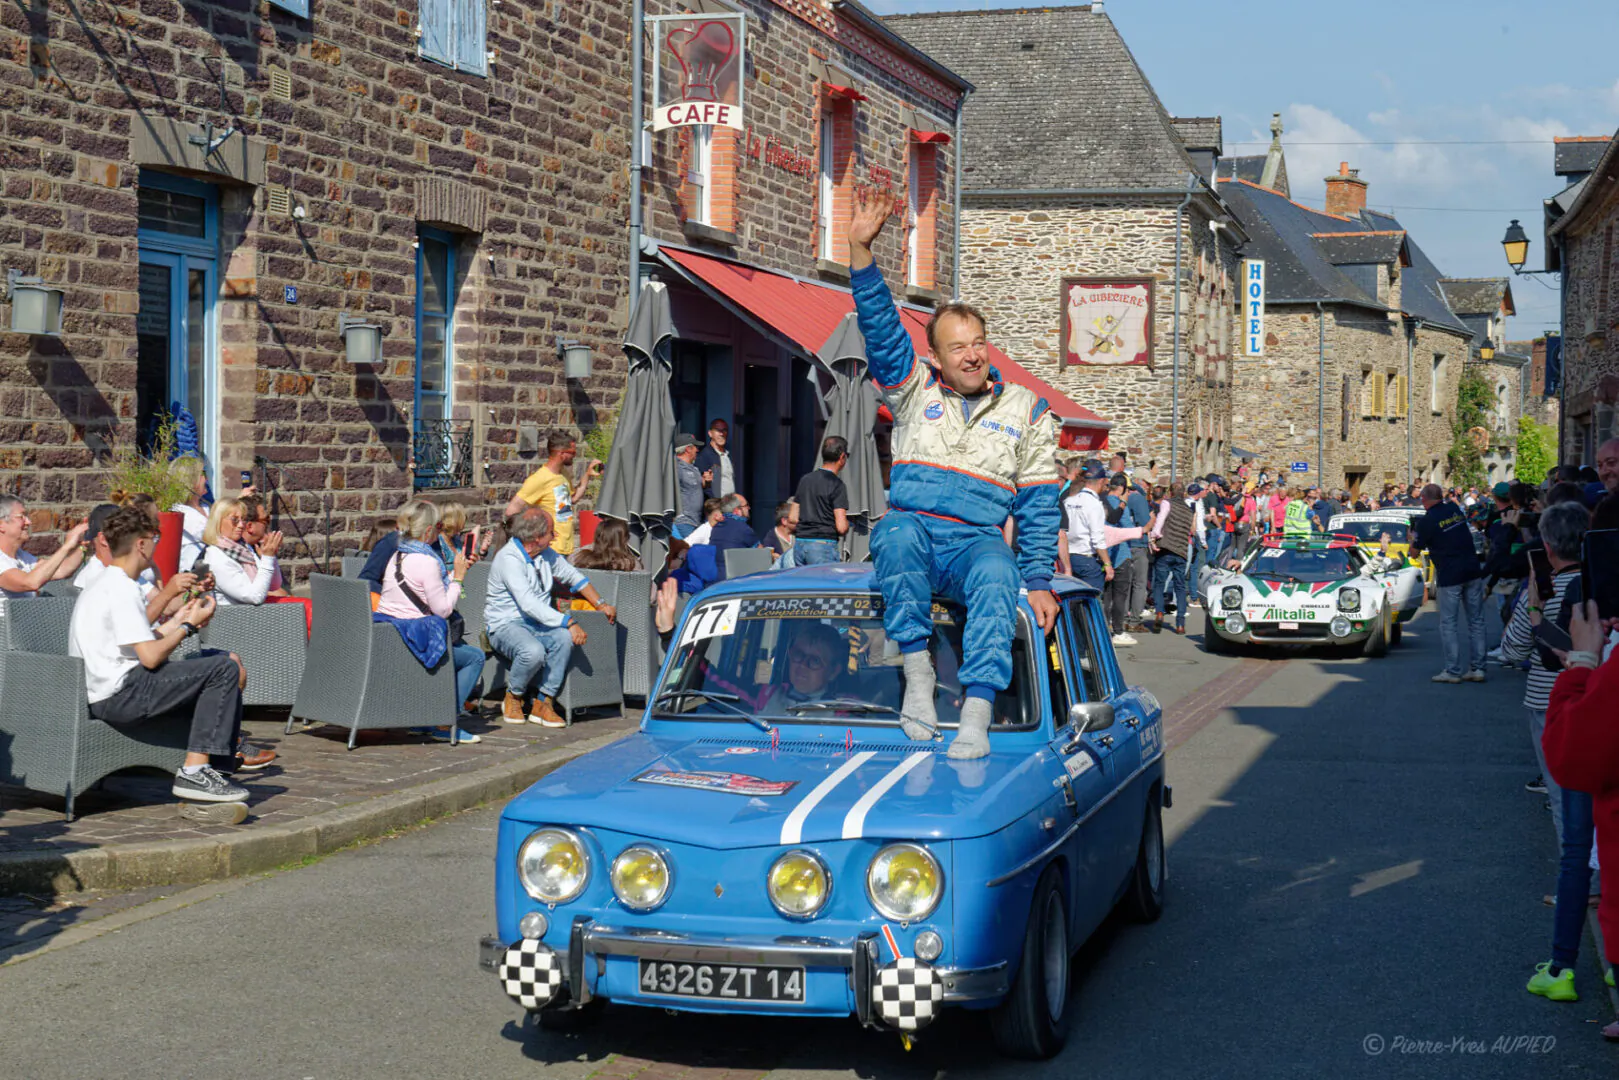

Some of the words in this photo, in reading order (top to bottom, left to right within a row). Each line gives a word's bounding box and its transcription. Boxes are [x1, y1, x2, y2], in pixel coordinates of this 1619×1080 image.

[667, 104, 730, 125] CAFE
[745, 125, 761, 160] La
[287, 288, 295, 299] 24
[1072, 296, 1087, 307] LA
[1089, 292, 1145, 307] GIBECIERE
[1249, 263, 1262, 353] HOTEL
[980, 420, 1000, 432] ALPINE
[764, 599, 811, 610] MARC
[854, 600, 870, 609] 02
[690, 603, 729, 639] 77
[1263, 608, 1316, 620] Alitalia
[641, 962, 713, 996] 4326
[720, 967, 757, 998] ZT
[766, 969, 802, 999] 14
